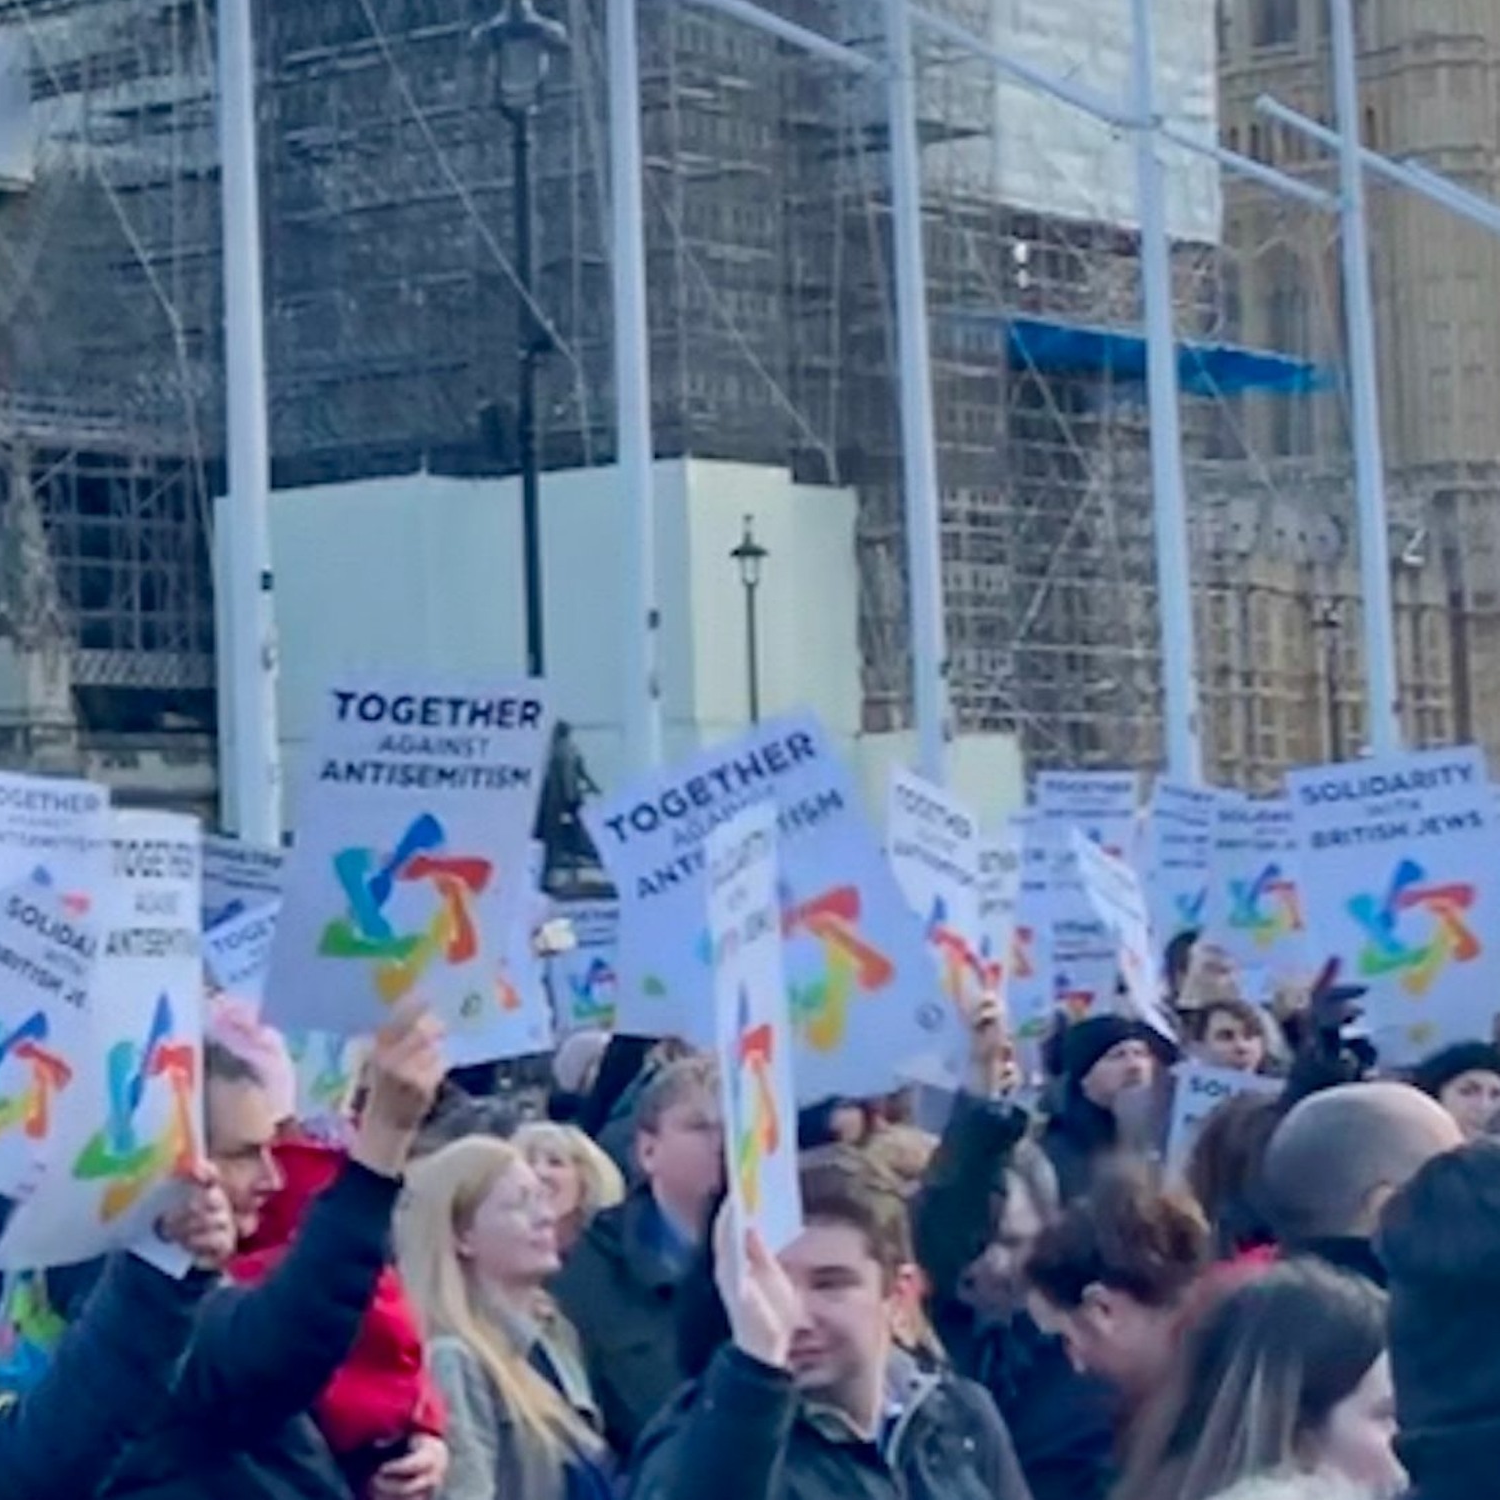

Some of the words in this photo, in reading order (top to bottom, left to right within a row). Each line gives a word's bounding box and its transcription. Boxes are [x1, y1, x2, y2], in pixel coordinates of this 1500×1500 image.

[331, 688, 543, 730] TOGETHER
[377, 734, 490, 759] AGAINST
[319, 759, 532, 790] ANTISEMITISM
[603, 731, 817, 844] TOGETHER
[1299, 763, 1474, 806] SOLIDARITY
[1309, 822, 1411, 849] BRITISH
[1415, 810, 1484, 837] JEWS
